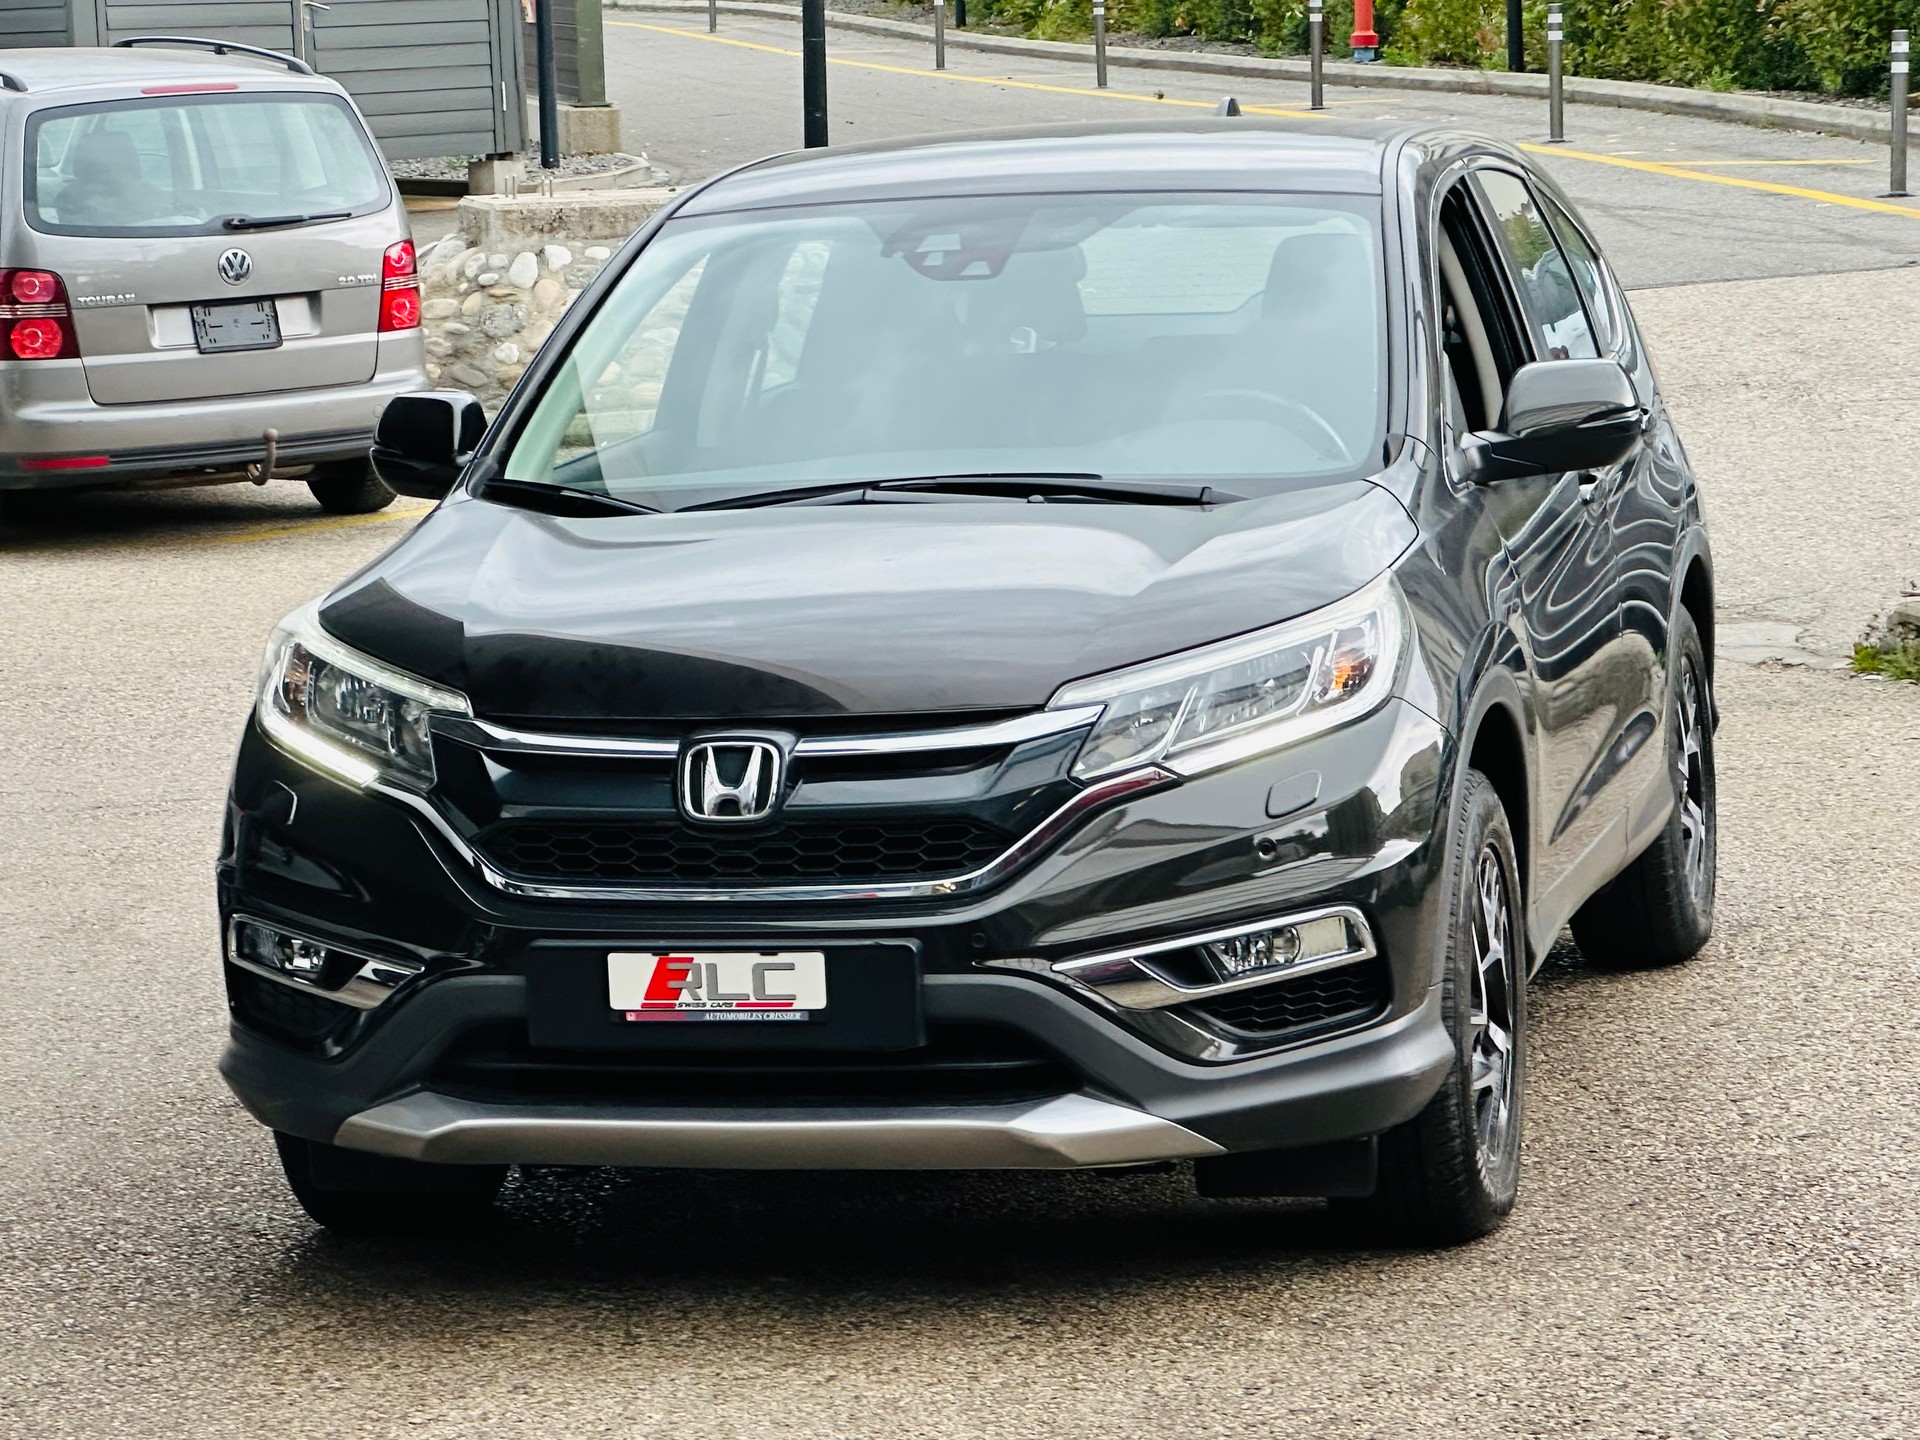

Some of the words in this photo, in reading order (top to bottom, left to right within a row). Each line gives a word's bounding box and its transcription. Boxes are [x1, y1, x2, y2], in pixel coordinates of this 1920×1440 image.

[77, 294, 136, 305] TOURAN
[704, 1011, 763, 1021] AUTOMOBILES
[763, 1011, 802, 1020] CRISSIER
